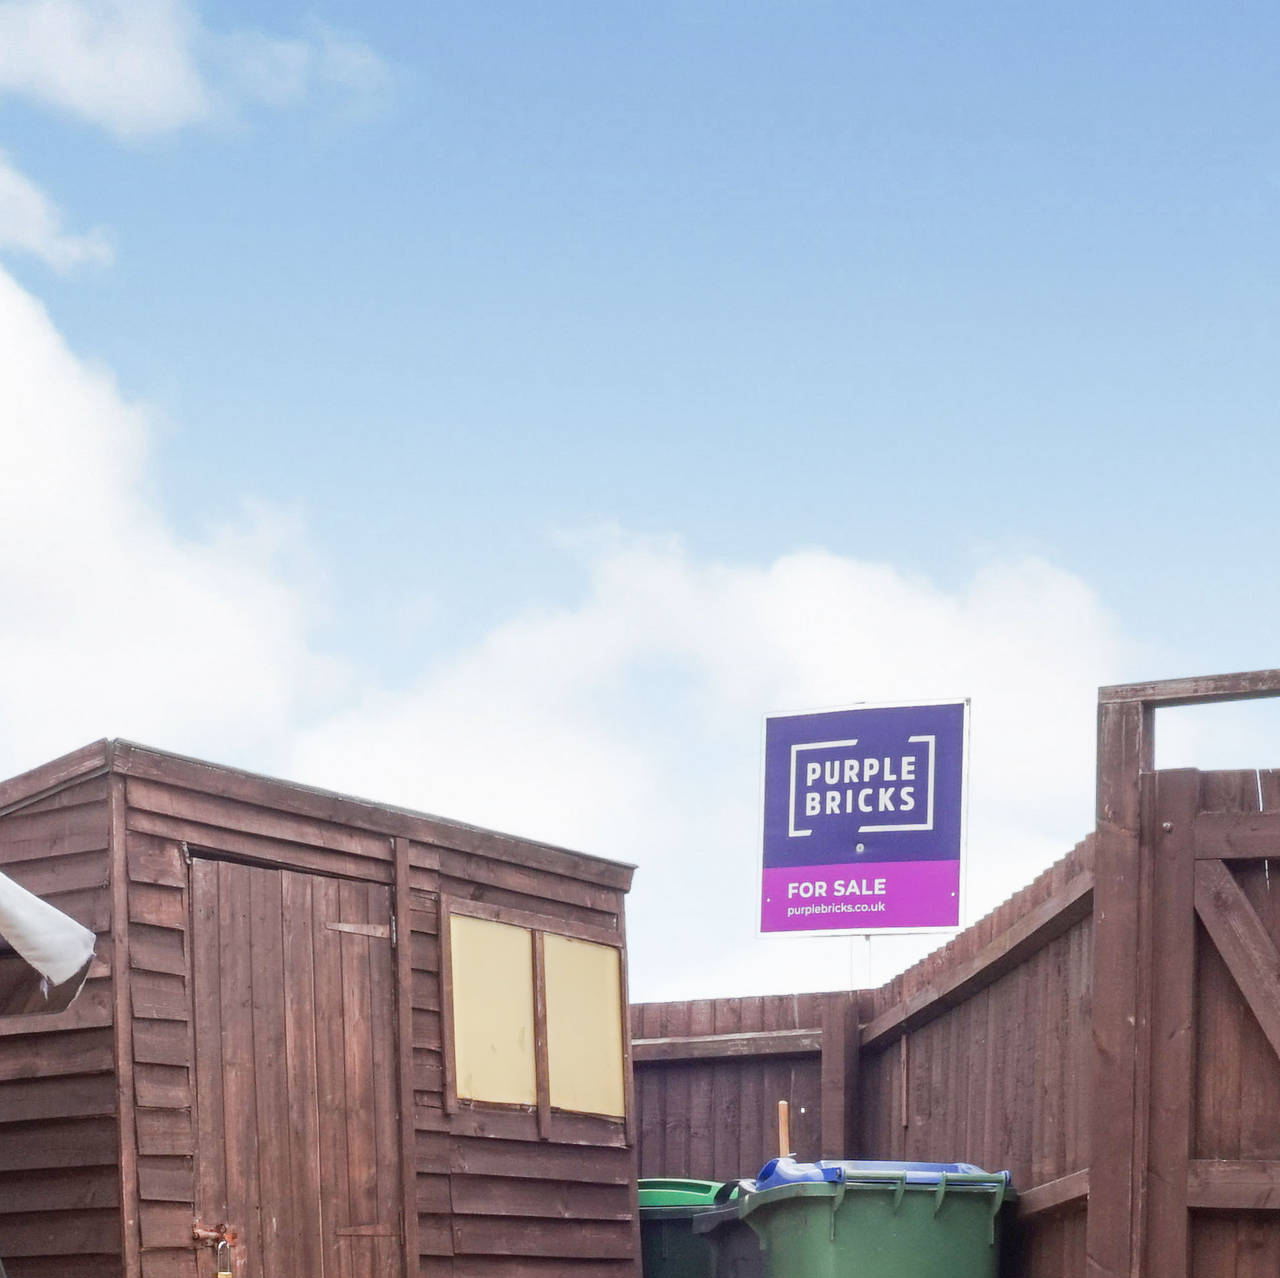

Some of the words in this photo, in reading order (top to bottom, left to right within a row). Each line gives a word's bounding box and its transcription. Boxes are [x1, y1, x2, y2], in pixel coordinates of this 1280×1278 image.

[806, 756, 916, 786] PURPLE
[805, 786, 915, 816] BRICKS
[787, 881, 827, 899] FOR
[833, 878, 886, 897] SALE
[787, 901, 886, 917] purplebricks.co.uk
